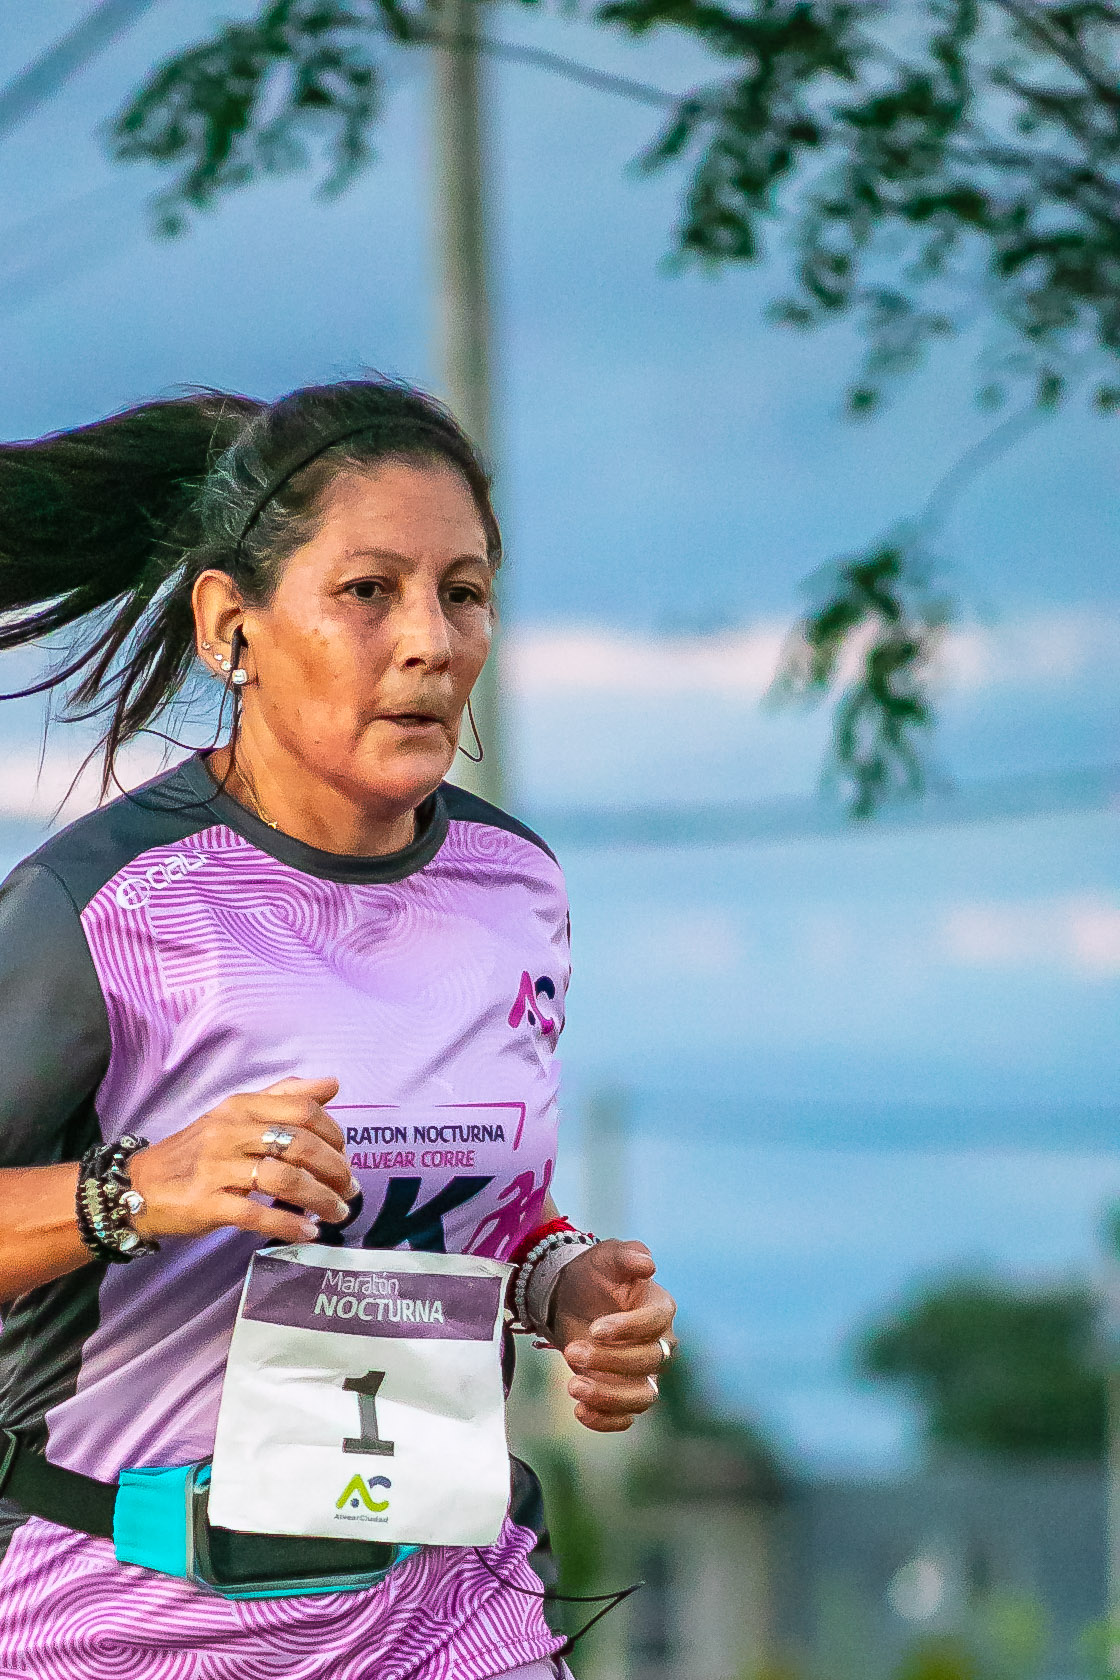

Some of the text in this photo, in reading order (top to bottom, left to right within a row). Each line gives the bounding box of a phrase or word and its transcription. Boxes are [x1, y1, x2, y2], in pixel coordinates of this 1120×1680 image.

[346, 1124, 506, 1145] RATON NOCTURNA
[350, 1149, 476, 1170] ALVEAR CORRE
[320, 1269, 399, 1296] Maratón
[313, 1293, 444, 1324] NOCTURNA
[342, 1371, 395, 1457] 1
